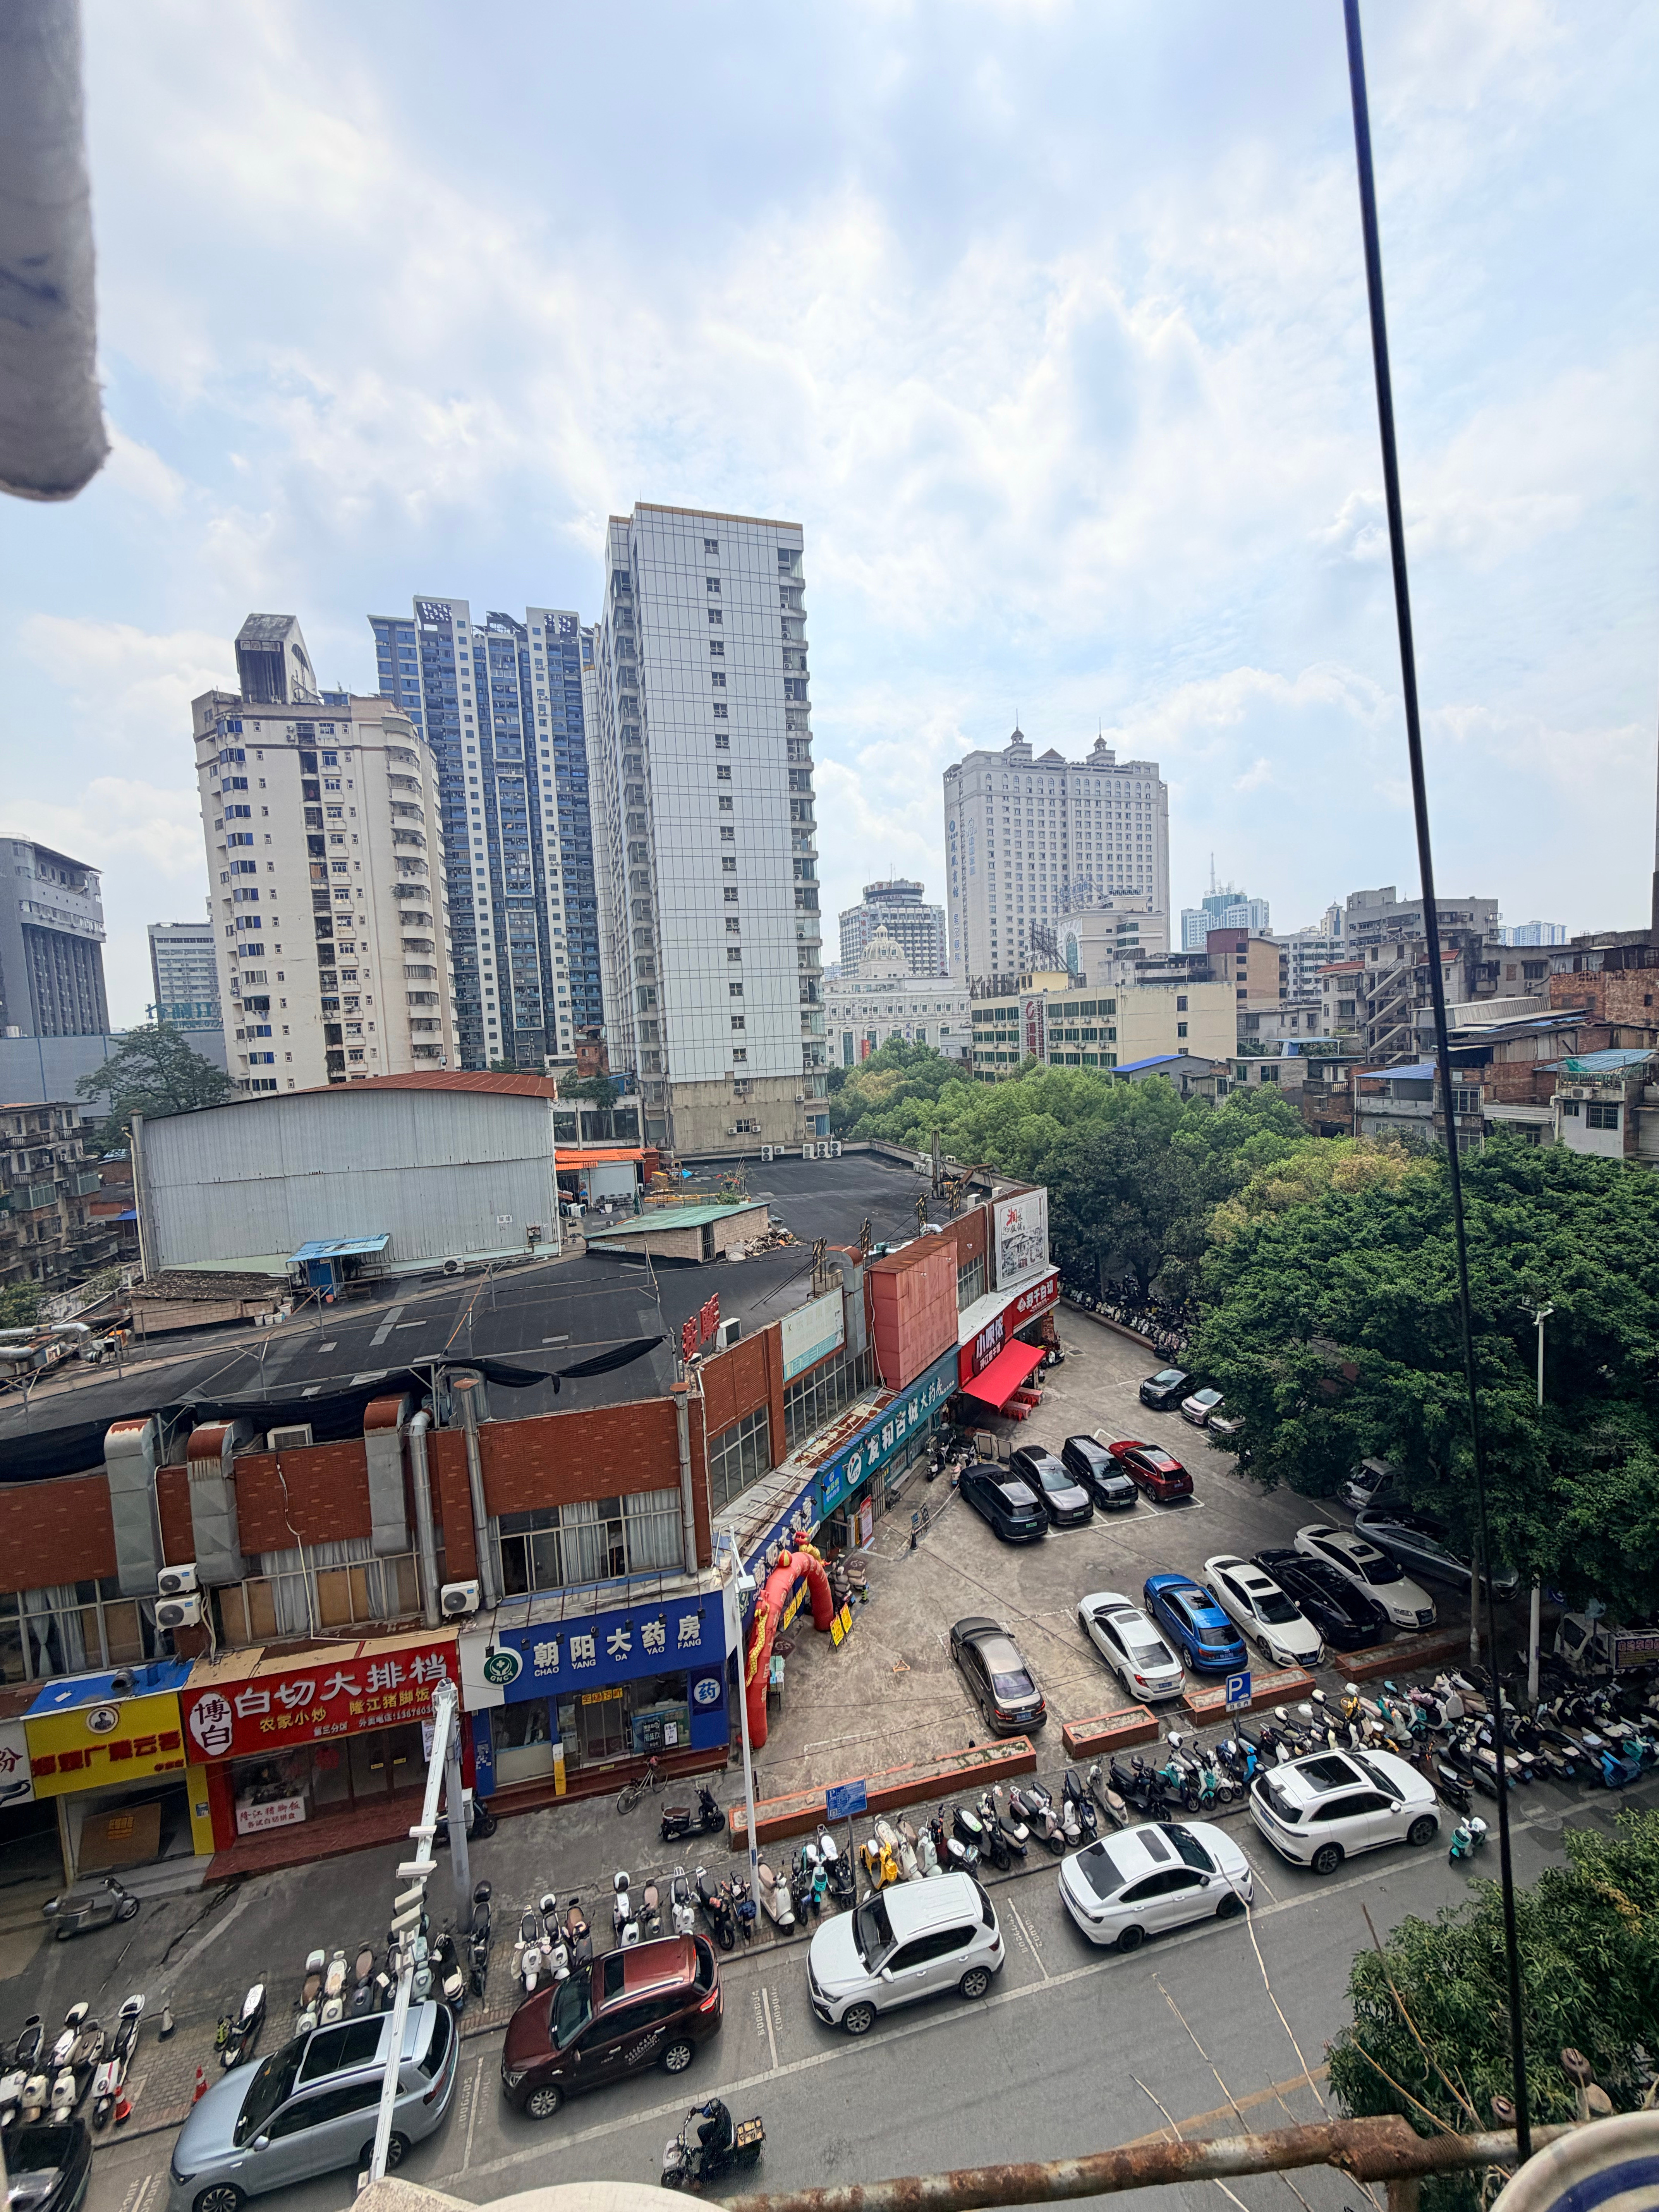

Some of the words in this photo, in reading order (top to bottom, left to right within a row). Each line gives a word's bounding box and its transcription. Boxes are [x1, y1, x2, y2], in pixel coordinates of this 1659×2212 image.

[534, 1615, 701, 1668] 朝阳大药房
[534, 1667, 559, 1677] CHAO
[572, 1659, 596, 1670] YANG
[647, 1646, 665, 1655] YAO
[678, 1638, 702, 1649] FANG
[234, 1654, 447, 1718] 白切大排档
[697, 1681, 716, 1700] 药
[1229, 1678, 1243, 1701] P
[194, 1699, 231, 1748] 博白
[260, 1706, 326, 1733] 农家小炒
[349, 1687, 431, 1716] 隆江猪脚饭
